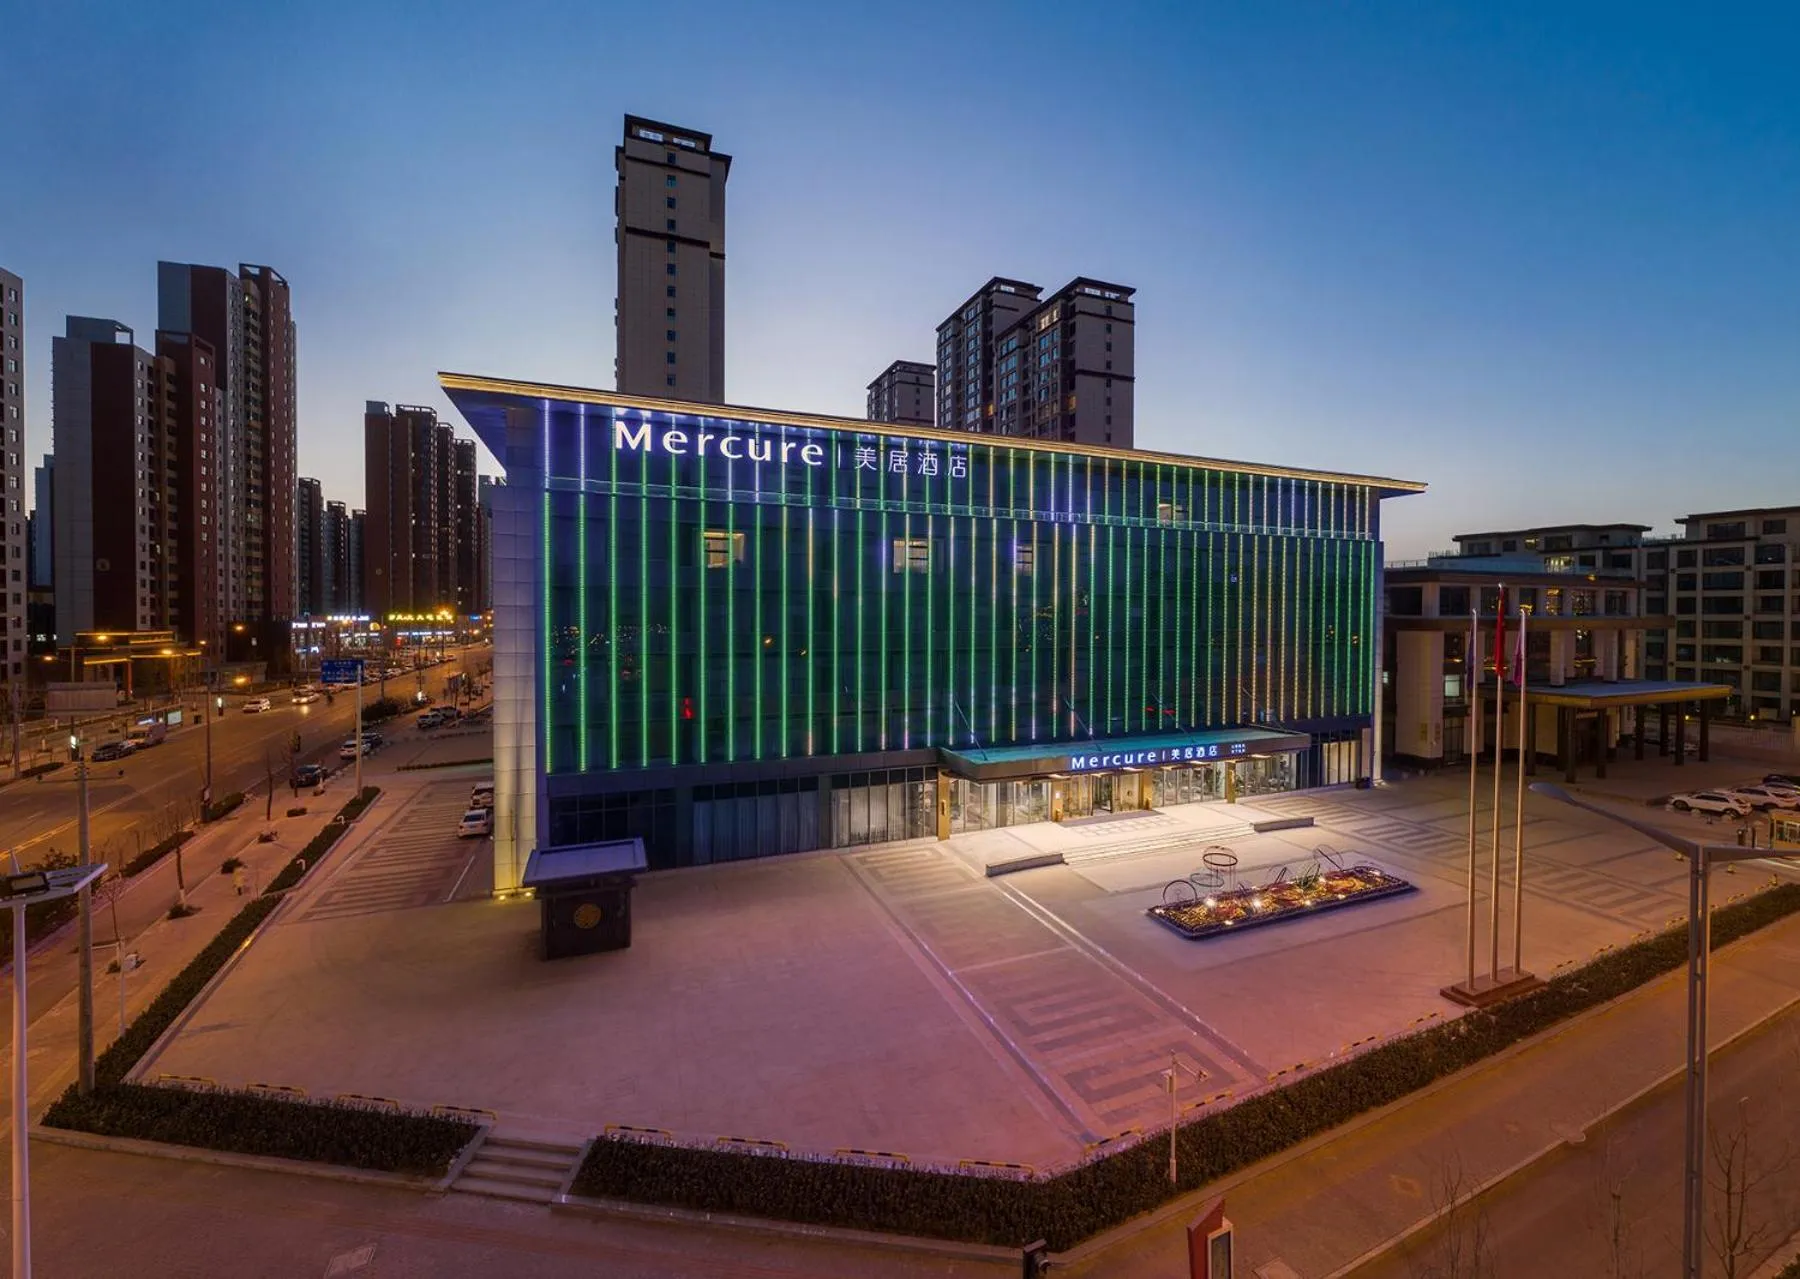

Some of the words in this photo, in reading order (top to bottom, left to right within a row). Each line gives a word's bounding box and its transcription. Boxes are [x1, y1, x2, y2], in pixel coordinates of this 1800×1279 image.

[614, 420, 824, 466] Mercure
[854, 446, 968, 479] 美居酒店
[1071, 751, 1156, 769] Mercure
